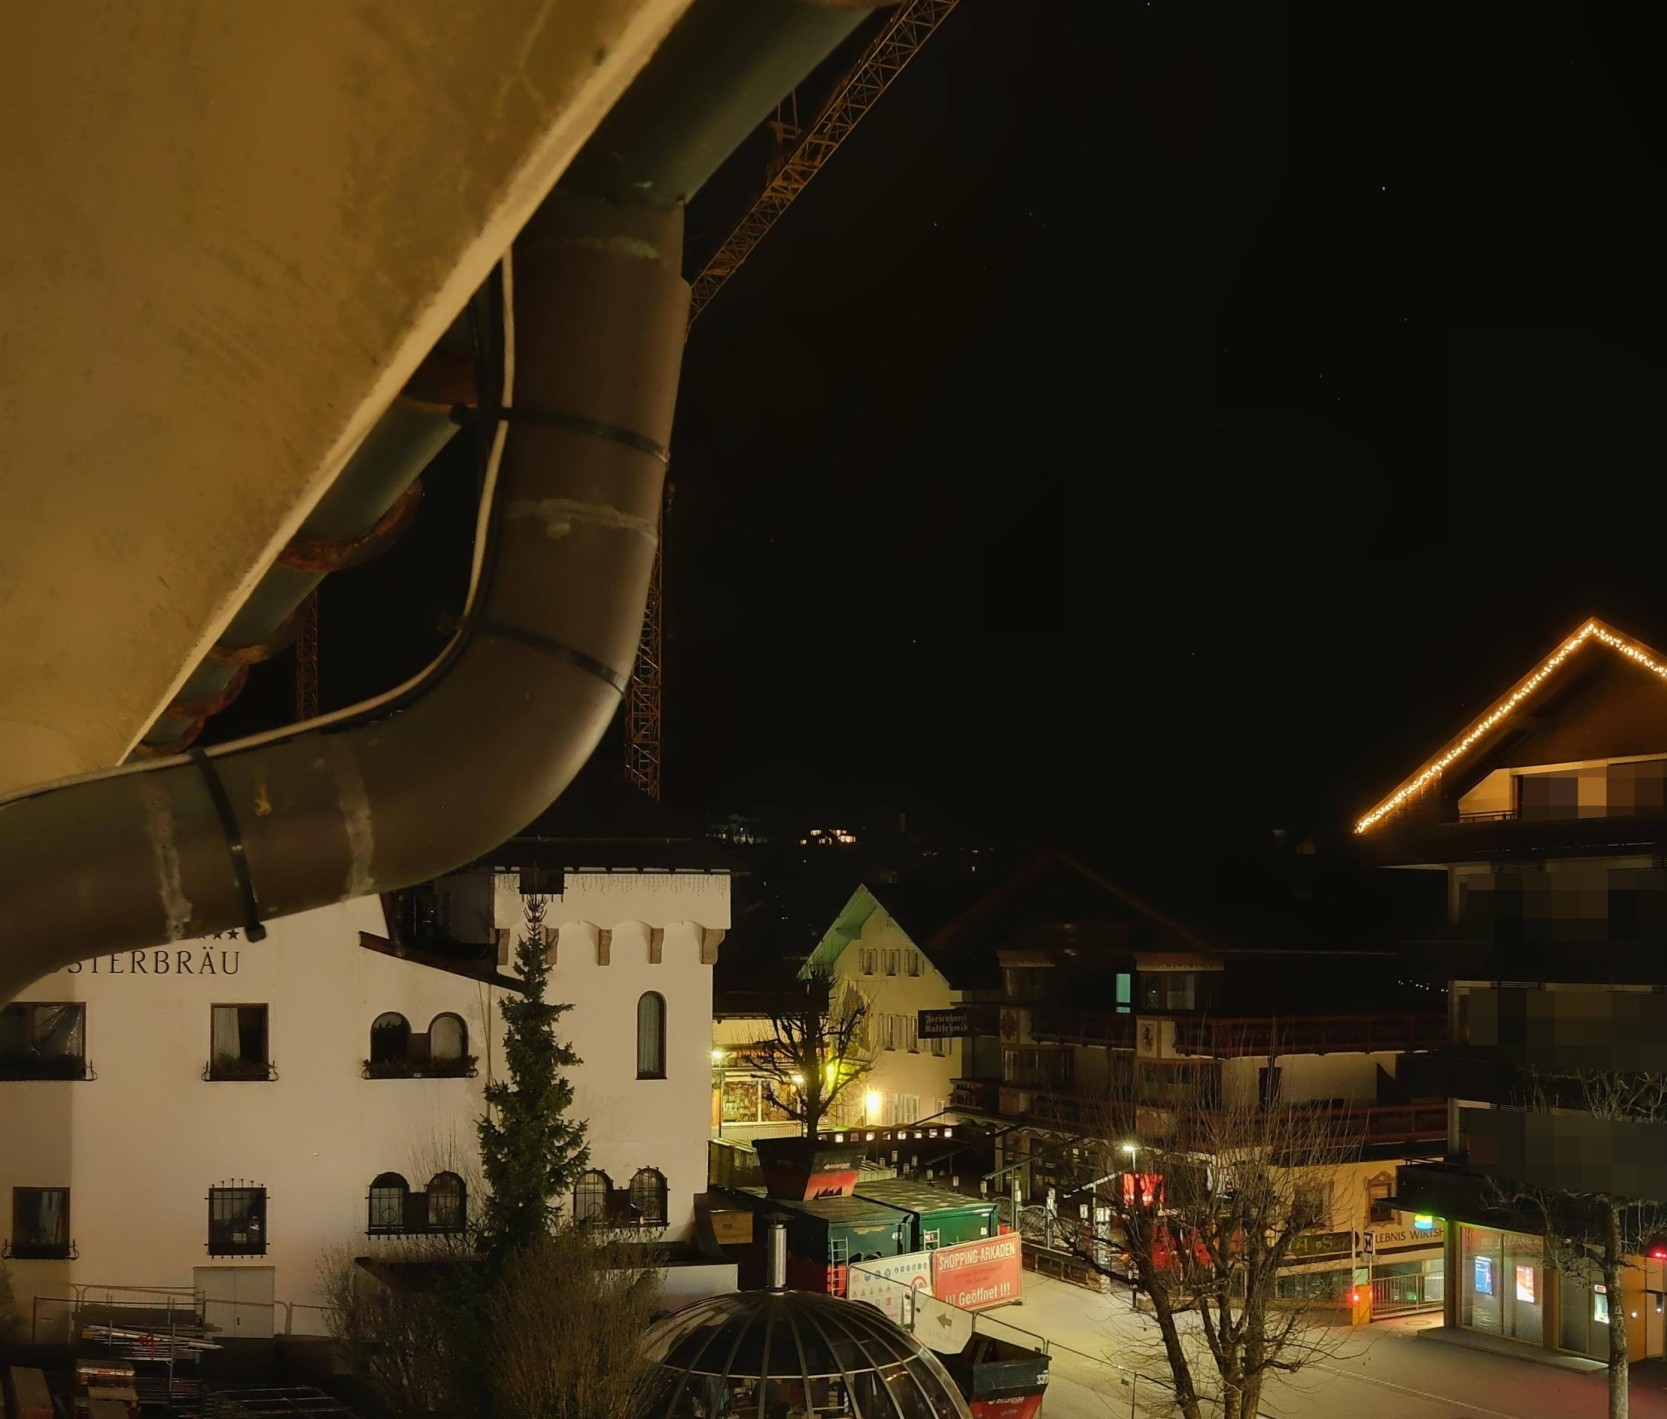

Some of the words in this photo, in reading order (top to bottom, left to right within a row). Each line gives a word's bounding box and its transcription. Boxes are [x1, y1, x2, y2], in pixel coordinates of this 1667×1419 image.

[54, 946, 240, 975] STERBRÄU
[1375, 1231, 1406, 1244] LEBNIS
[939, 1242, 1016, 1271] SHOPPING-ARKADEN
[959, 1285, 998, 1307] Geöffnet
